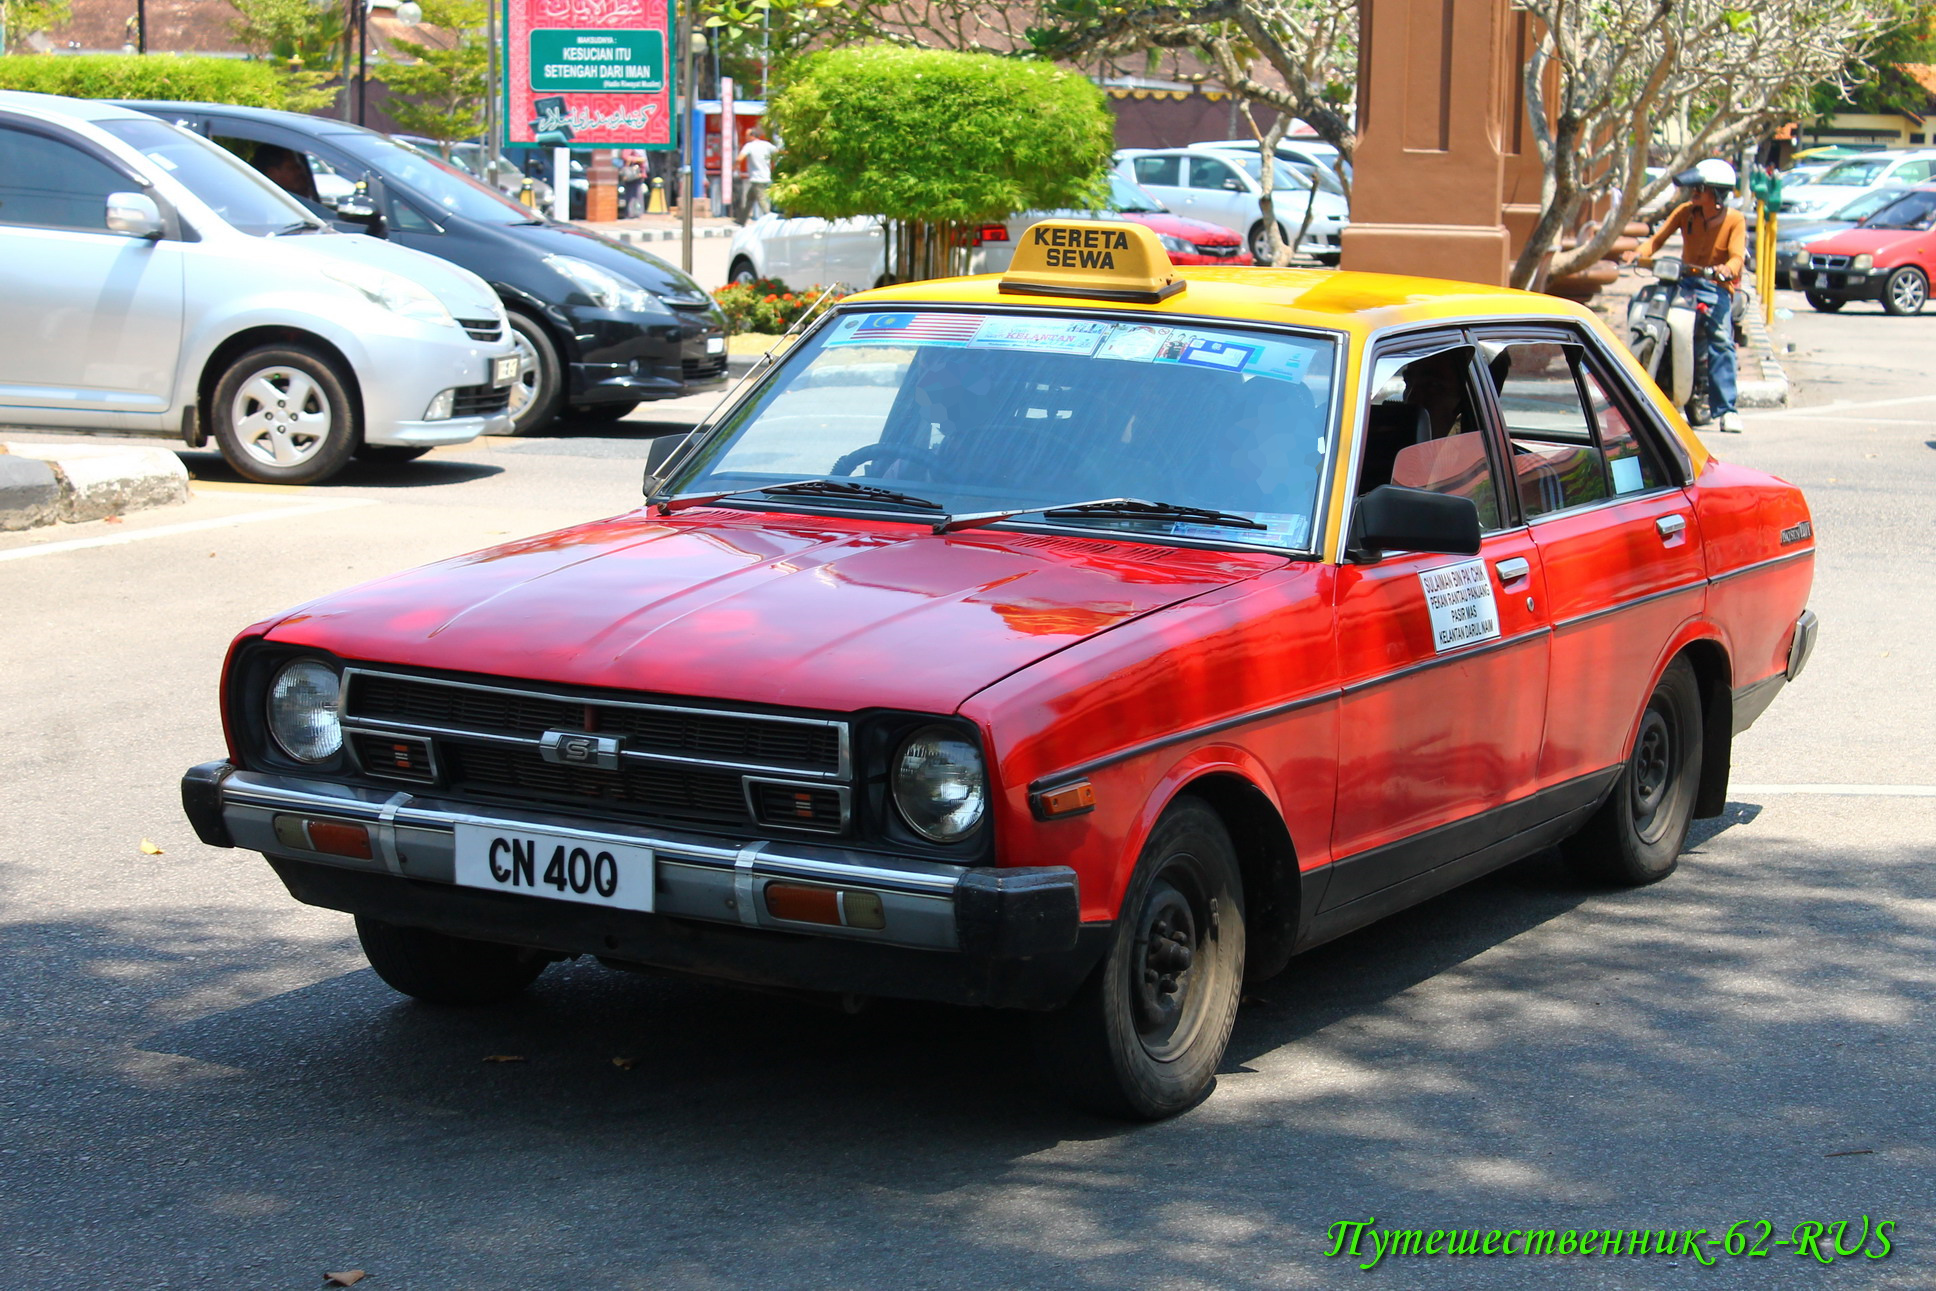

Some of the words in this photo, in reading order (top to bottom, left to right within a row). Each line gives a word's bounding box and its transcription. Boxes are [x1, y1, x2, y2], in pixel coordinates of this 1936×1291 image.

[563, 47, 613, 61] KESUCIAN
[615, 47, 632, 61] ITU
[544, 64, 598, 78] SETENGAH
[600, 65, 623, 78] DARI
[625, 65, 651, 78] IMAN
[1034, 227, 1129, 250] KERETA
[1046, 248, 1115, 270] SEWA
[1006, 332, 1076, 342] KELANTAN
[1424, 572, 1454, 593] SULAIMAN
[1451, 570, 1464, 587] BIN
[1470, 565, 1486, 582] CHIK
[1430, 593, 1448, 610] PEKAN
[1447, 589, 1469, 606] RANTAU
[1467, 583, 1490, 601] PANJANG
[1451, 607, 1467, 623] PASIR
[1465, 604, 1478, 619] MAS
[1439, 626, 1465, 645] KELANTAN
[1464, 622, 1482, 639] DARUL
[1481, 618, 1493, 635] NAIM
[488, 837, 535, 887] CN
[543, 844, 618, 898] 400
